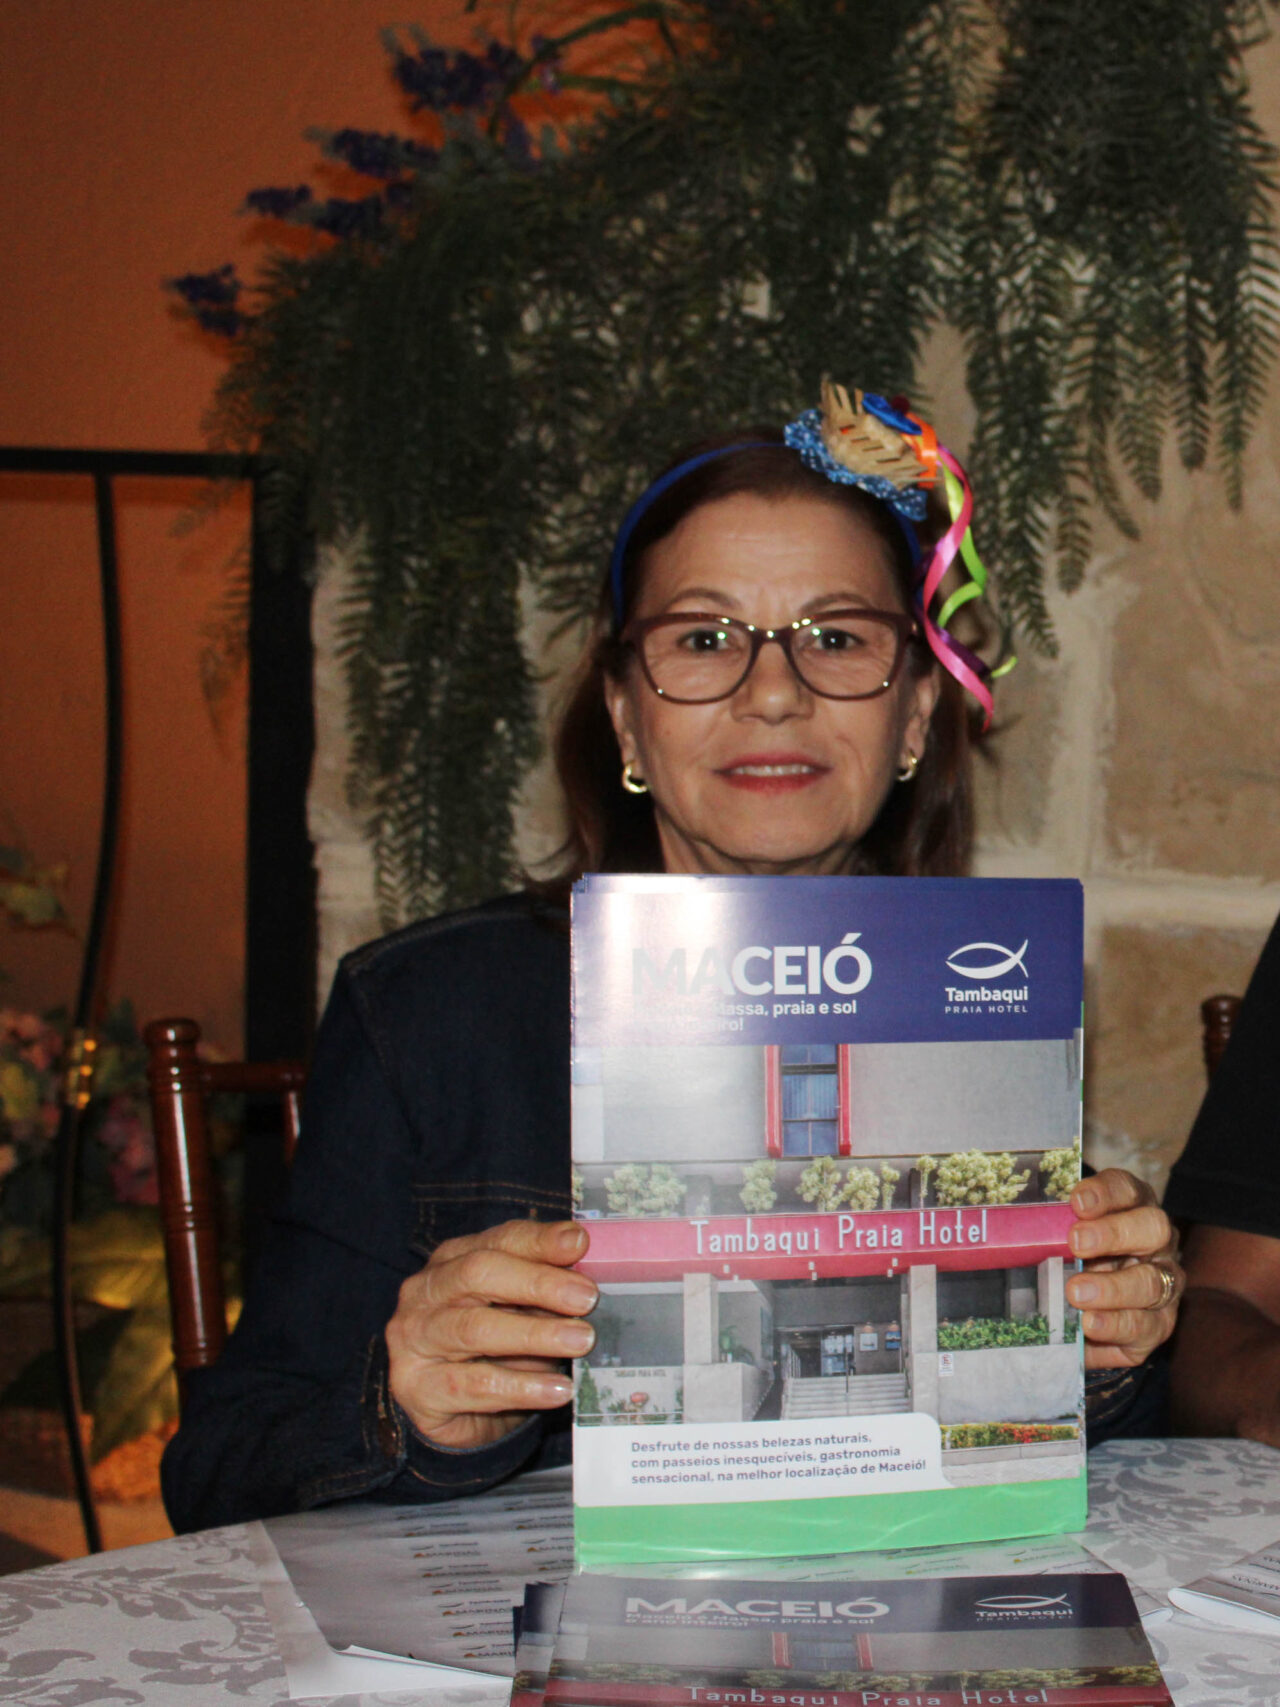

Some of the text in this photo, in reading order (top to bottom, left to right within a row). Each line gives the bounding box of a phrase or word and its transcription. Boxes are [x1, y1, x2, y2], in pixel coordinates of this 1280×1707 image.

[632, 932, 873, 997] MACEIÓ
[945, 986, 1029, 1003] Tambaqui
[773, 1000, 815, 1018] praia
[819, 1003, 829, 1014] e
[833, 1000, 857, 1015] sol
[945, 1005, 1028, 1014] PRAIA HOTEL
[690, 1208, 989, 1256] Tambaqui Praia Hotel
[631, 1432, 872, 1453] Desfrute de nossas belezas naturais,
[631, 1459, 659, 1468] com
[662, 1455, 720, 1470] passeios
[820, 1446, 901, 1463] gastronomia
[631, 1459, 926, 1484] sensacional, na melhor localização de Maceió!
[625, 1596, 890, 1618] MACEIÓ
[975, 1608, 1074, 1619] Tambaqui
[781, 1617, 826, 1626] praia
[684, 1686, 1048, 1706] Tambaqui Praia Hotel
